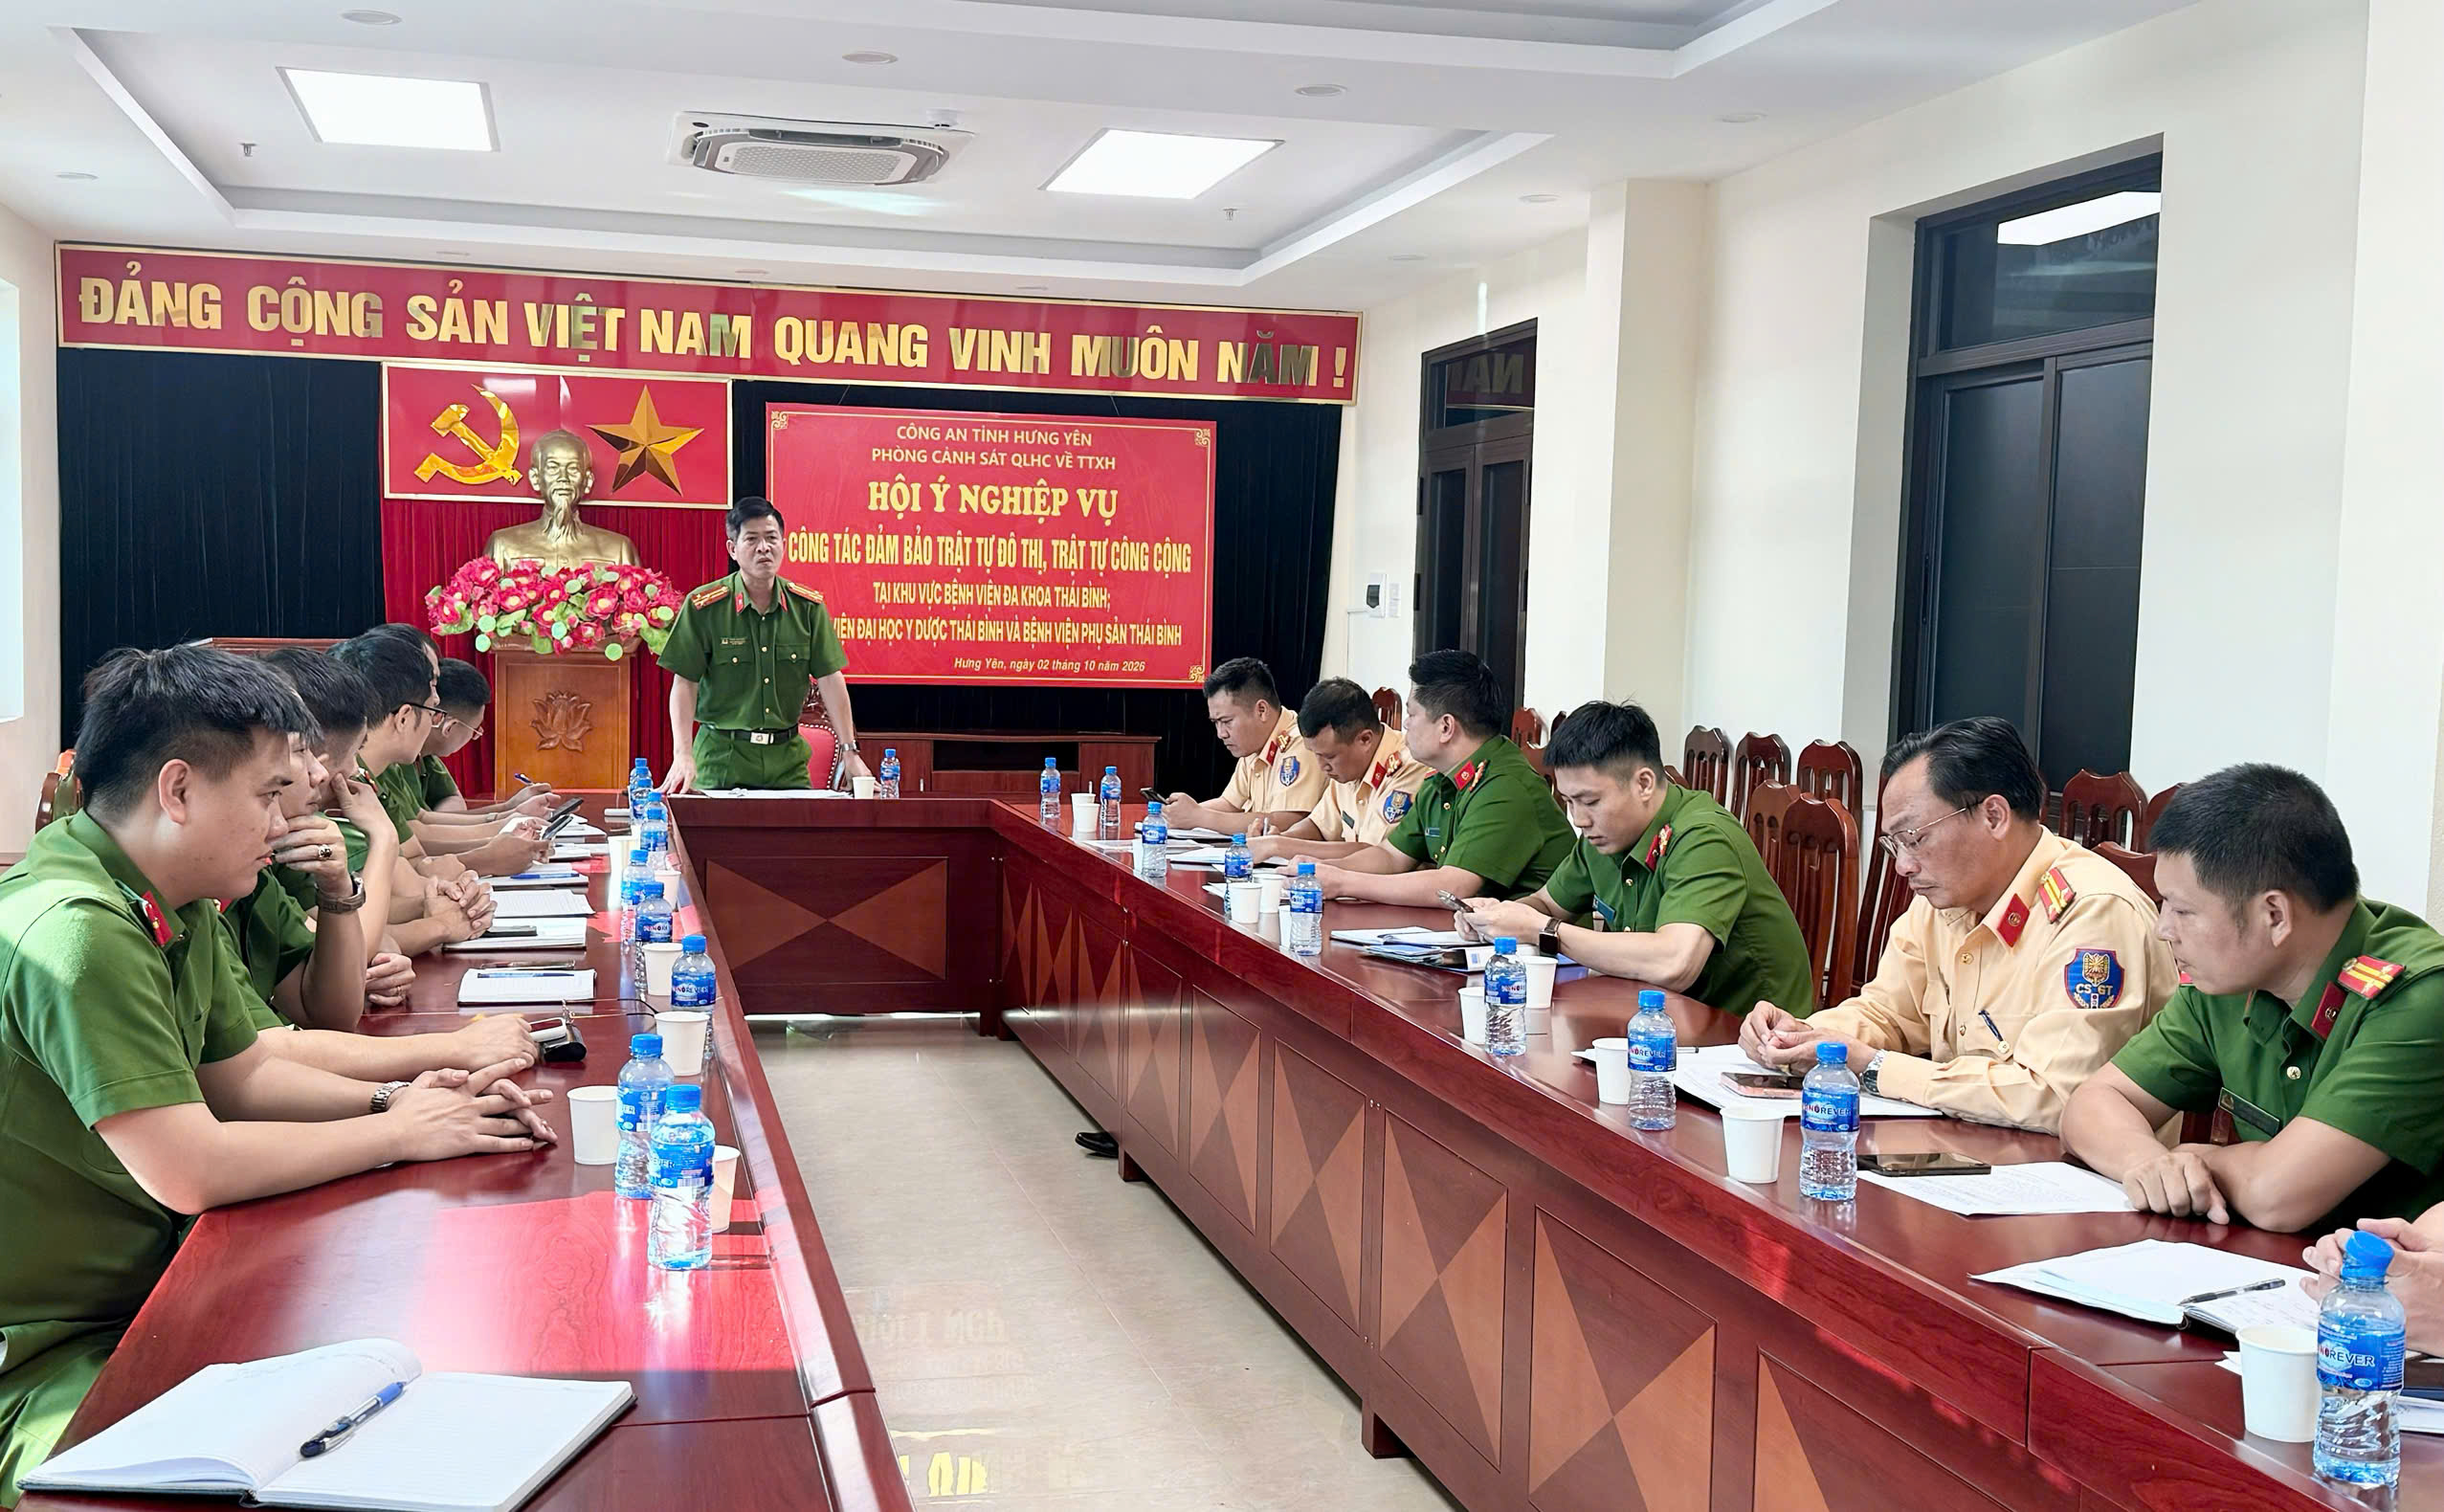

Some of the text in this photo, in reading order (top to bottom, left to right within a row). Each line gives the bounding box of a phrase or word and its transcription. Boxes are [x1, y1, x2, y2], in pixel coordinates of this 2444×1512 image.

[78, 260, 1347, 388] ĐẢNG CỘNG SẢN VIỆT NAM QUANG VINH MUÔN NĂM !
[897, 423, 1092, 447] CÔNG AN TỈNH HƯNG YÊN
[872, 445, 1116, 470] PHÒNG CẢNH SÁT QLHC VỀ TTXH
[868, 473, 1119, 526] HỘI Ý NGHIỆP VỤ
[788, 523, 1191, 579] CÔNG TÁC ĐẢM BẢO TRẬT TỰ ĐÔ THỊ, TRẬT TỰ CÔNG CỘNG
[873, 578, 1111, 612] TẠI KHU VỰC BỆNH VIỆN ĐA KHOA THÁI BÌNH;
[856, 617, 877, 646] ĐẠI
[878, 618, 903, 647] HỌC
[905, 619, 914, 640] Y
[915, 616, 947, 648] DƯỢC
[949, 613, 976, 641] THÁI
[977, 613, 1004, 642] BÌNH
[1006, 614, 1021, 642] VÀ
[1023, 616, 1052, 650] BỆNH
[1055, 617, 1079, 651] VIỆN
[1081, 623, 1102, 651] PHỤ
[1105, 615, 1127, 644] SẢN
[1129, 617, 1154, 645] THÁI
[1156, 617, 1182, 646] BÌNH
[954, 657, 981, 671] Hưng
[1010, 659, 1034, 673] ngày
[1037, 659, 1050, 670] 02
[1052, 659, 1081, 674] tháng
[1084, 660, 1096, 671] 10
[1098, 661, 1119, 672] năm
